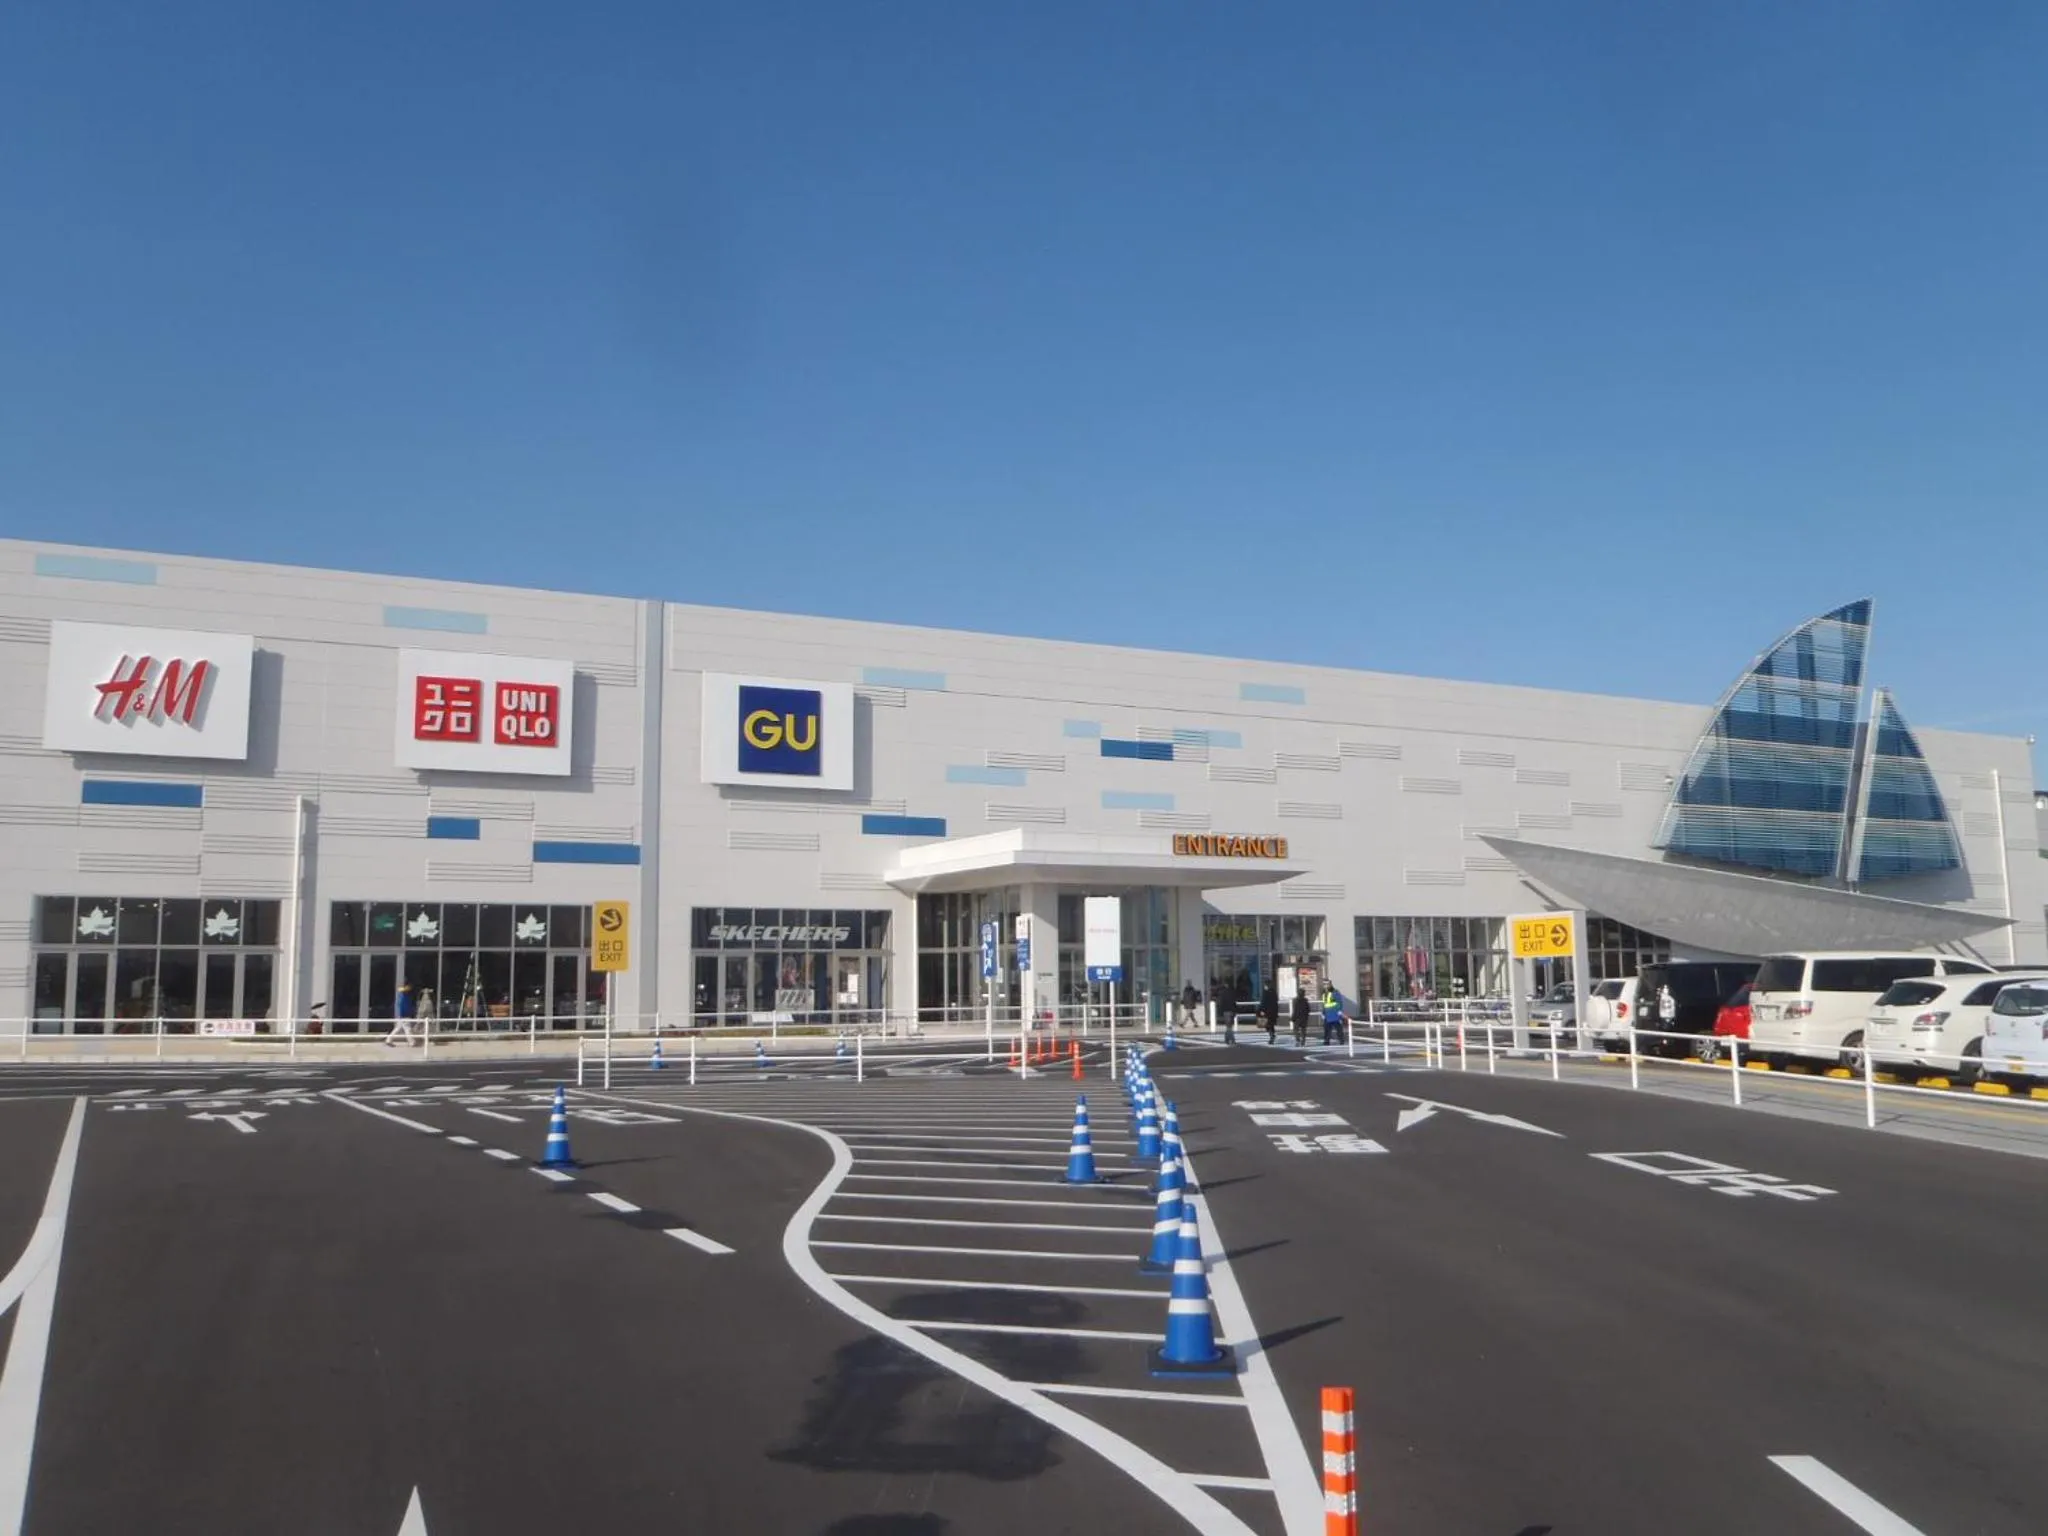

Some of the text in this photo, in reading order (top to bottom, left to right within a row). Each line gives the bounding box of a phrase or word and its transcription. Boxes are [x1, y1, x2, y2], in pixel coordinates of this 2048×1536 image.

[94, 654, 210, 725] H&M
[424, 684, 473, 707] ユニ
[502, 689, 547, 713] UNI
[421, 709, 472, 733] クロ
[501, 714, 550, 740] QLO
[743, 709, 816, 752] GU
[1173, 833, 1288, 858] ENTRANCE
[708, 925, 851, 941] SKECHERS
[1519, 923, 1546, 939] 出口
[599, 940, 623, 951] 出口
[600, 952, 621, 962] EXIT
[1522, 940, 1545, 952] EXIT
[1587, 1150, 1840, 1200] 出口
